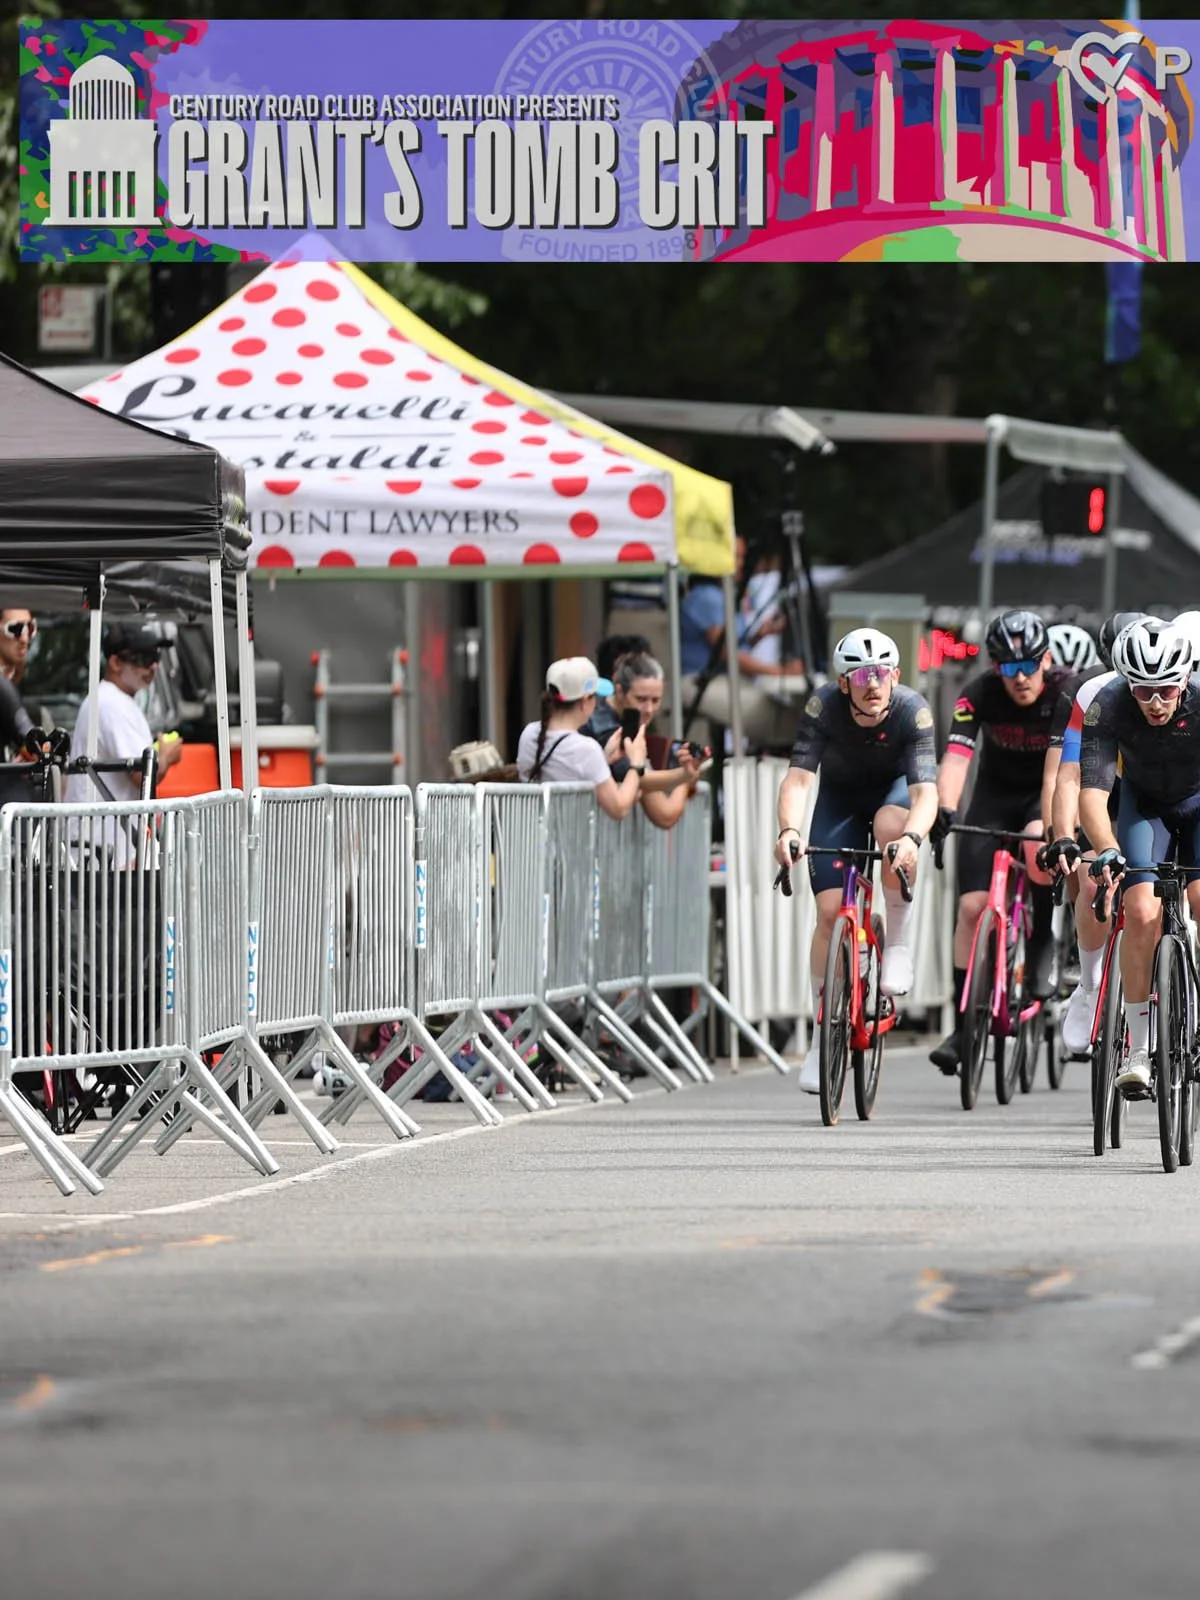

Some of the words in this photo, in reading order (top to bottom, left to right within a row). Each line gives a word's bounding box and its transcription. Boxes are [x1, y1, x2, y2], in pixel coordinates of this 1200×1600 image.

[118, 374, 474, 422] Lucarelli
[243, 443, 452, 470] staldi
[246, 509, 357, 536] IDENT
[368, 508, 520, 535] LAWYERS
[415, 864, 426, 945] NYPD
